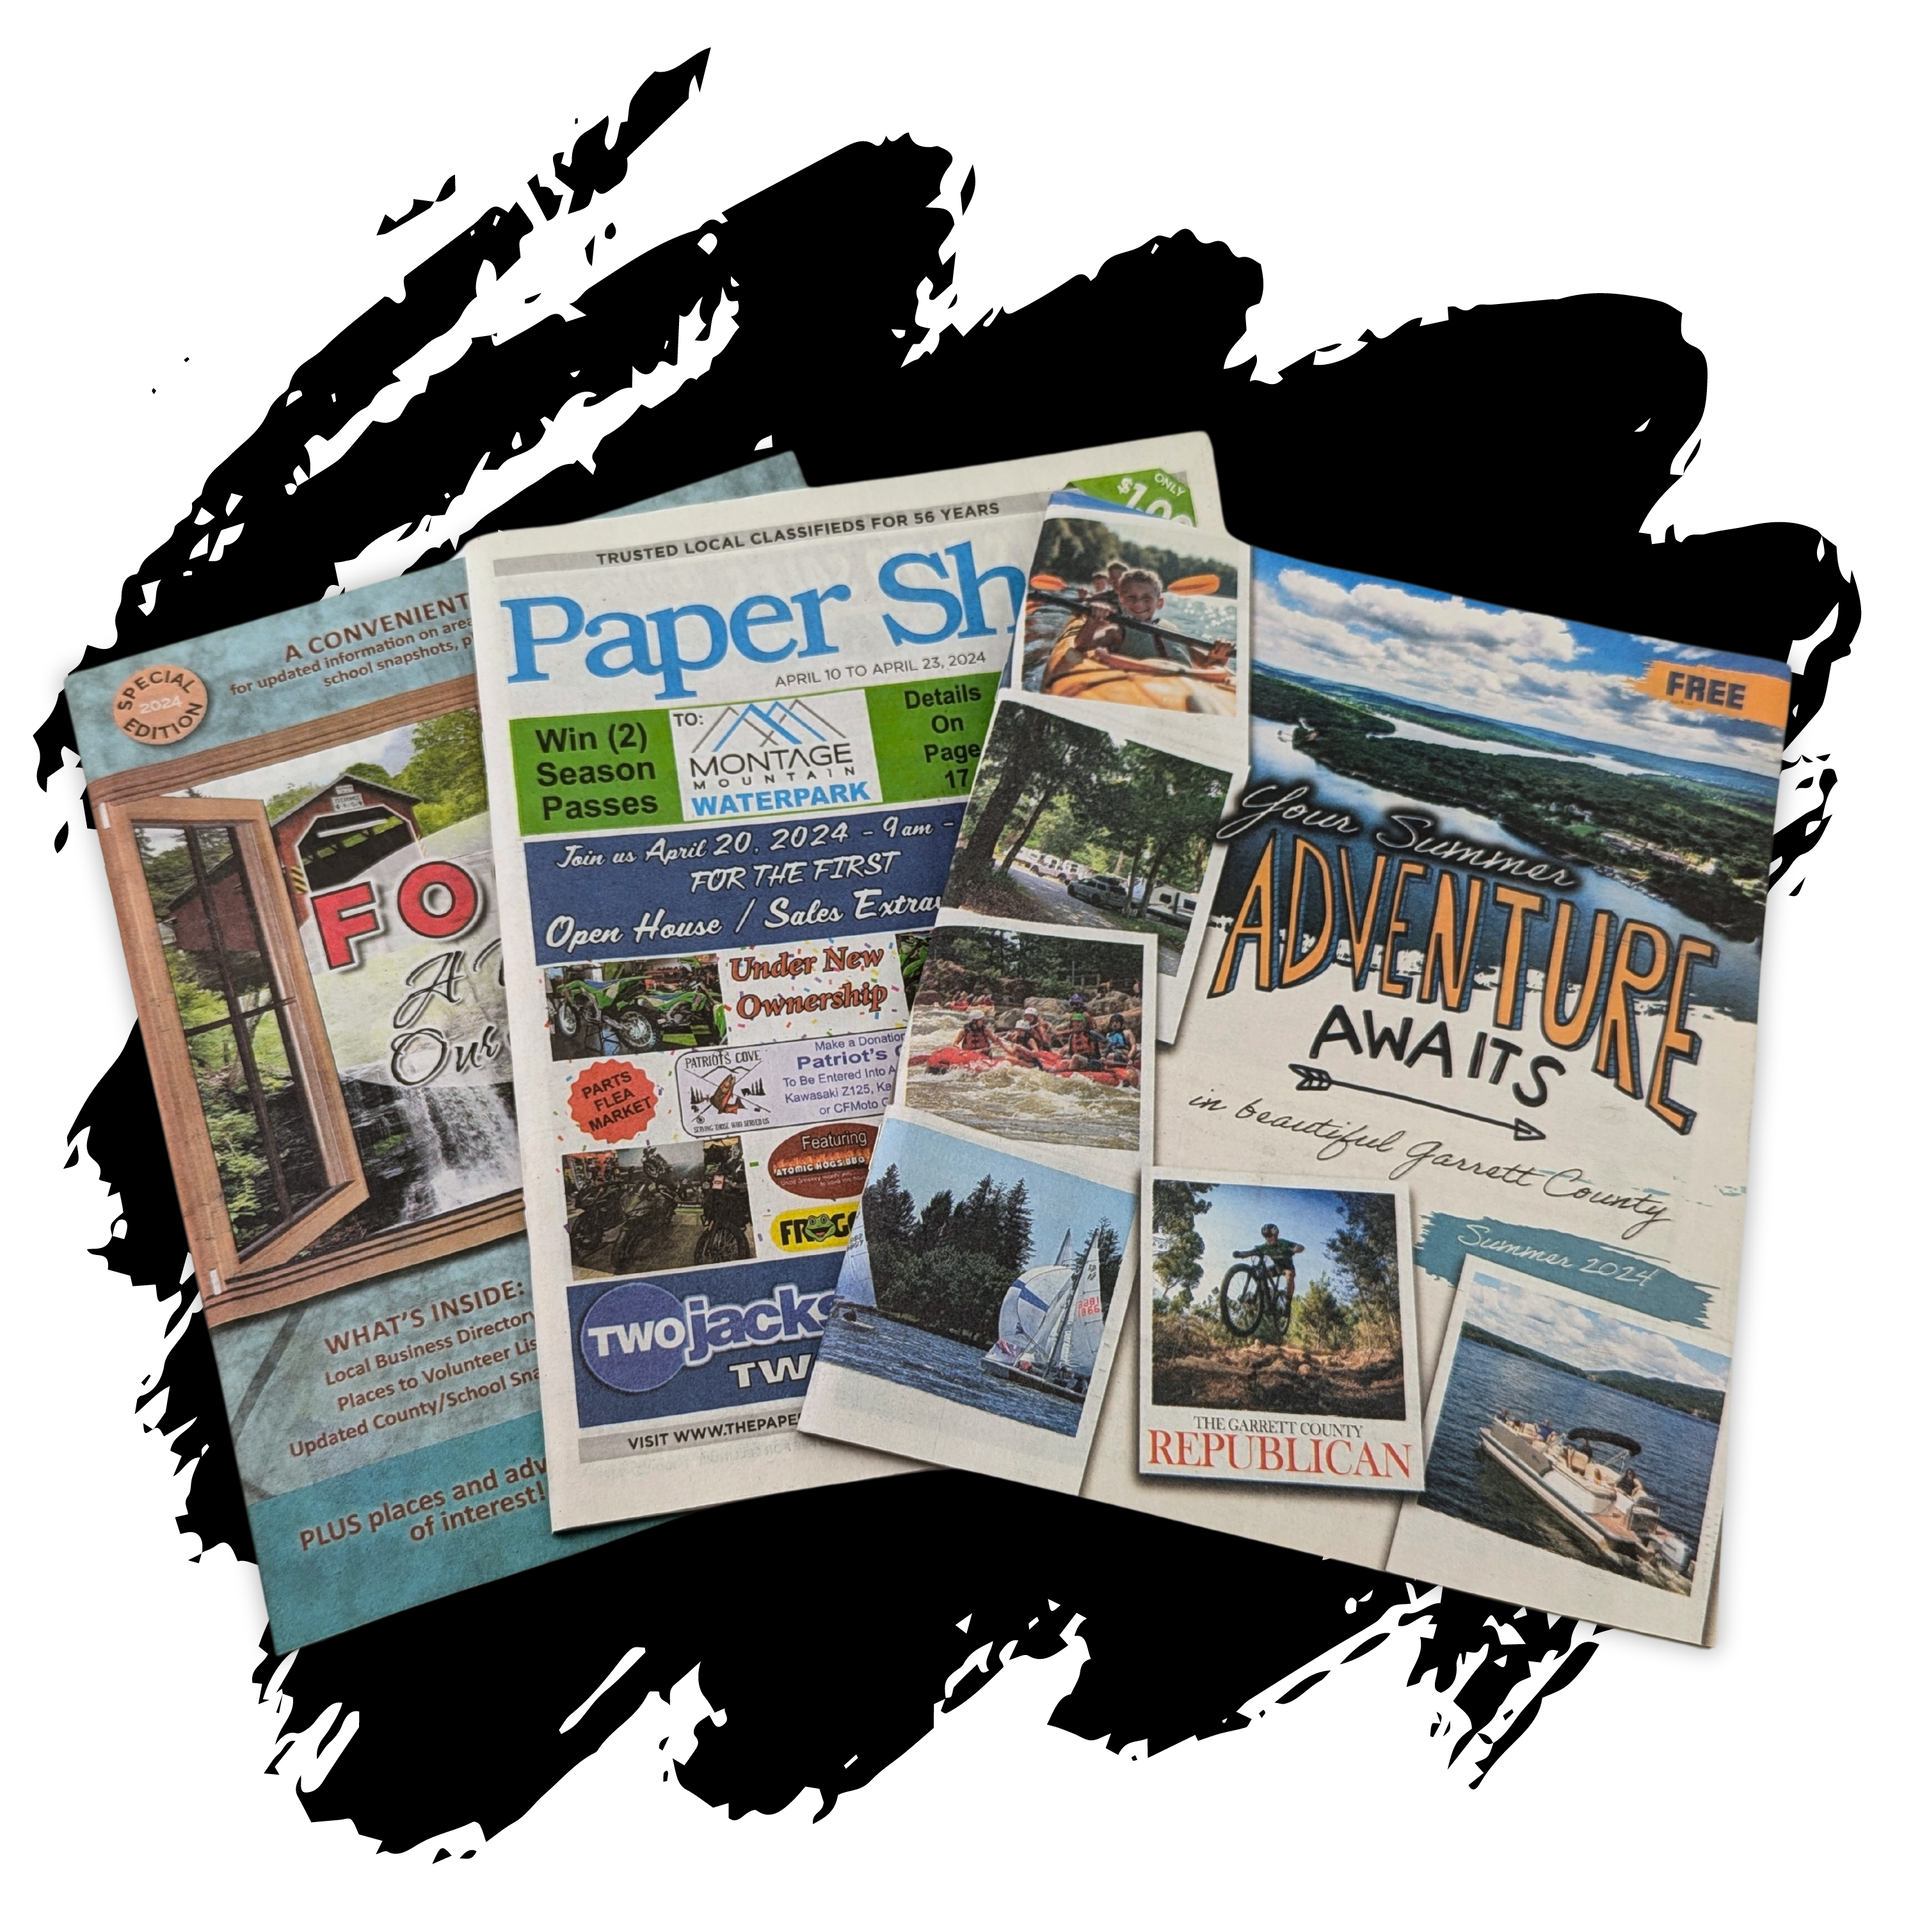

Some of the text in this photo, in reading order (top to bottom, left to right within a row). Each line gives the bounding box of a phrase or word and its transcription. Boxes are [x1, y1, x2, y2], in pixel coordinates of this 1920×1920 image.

[1155, 474, 1186, 497] ONLY
[596, 502, 1000, 565] TRUSTED LOCAL CLASSIFIEDS FOR 56 YEARS
[285, 592, 469, 663] A CONVENIENT
[499, 540, 1027, 701] Paper Sh
[230, 682, 253, 696] for
[258, 660, 322, 689] updated
[324, 634, 415, 669] information
[419, 627, 439, 641] on
[324, 664, 373, 687] school
[377, 640, 459, 671] snapshots,
[775, 651, 986, 688] APRIL 10 TO APRIL 23, 2024
[117, 670, 196, 711] SPECIAL
[139, 695, 183, 715] 2024
[903, 684, 982, 711] Details
[1665, 671, 1747, 710] FREE
[123, 702, 204, 740] EDITION
[534, 722, 648, 755] Win (2)
[673, 713, 704, 728] TO:
[931, 715, 964, 734] On
[689, 743, 855, 778] MONTAGE
[924, 743, 981, 764] Page
[535, 759, 656, 788] Season
[693, 766, 855, 790] MOUNTAIN
[945, 768, 969, 789] 17
[542, 793, 659, 821] Passes
[691, 781, 871, 817] WATERPARK
[1216, 785, 1359, 839] Your
[557, 845, 605, 869] Join
[612, 852, 636, 864] us
[645, 838, 707, 865] April
[769, 822, 849, 851] 2024
[1376, 814, 1574, 887] Summer
[690, 850, 902, 893] FOR THE FIRST
[310, 861, 479, 970] FO
[546, 915, 624, 953] Open
[634, 908, 723, 943] House
[765, 896, 843, 929] Sales
[729, 946, 885, 982] Under New
[1209, 828, 1720, 1136] ADVENTURE
[736, 982, 888, 1019] Ownership
[391, 1026, 499, 1086] Our
[735, 1050, 762, 1064] COVE
[797, 1048, 888, 1070] Patriot's
[814, 1040, 845, 1052] Make
[848, 1039, 856, 1047] a
[1309, 1005, 1566, 1107] AWAITS
[581, 1070, 633, 1099] PARTS
[783, 1065, 897, 1088] To Be Entered Into A
[785, 1082, 892, 1104] Kawasaki Z125, Ka
[588, 1097, 653, 1132] MARKET
[593, 1088, 636, 1113] FLEA
[819, 1106, 831, 1116] or
[834, 1100, 879, 1114] CFMoto
[693, 1125, 714, 1134] SERVING
[714, 1123, 730, 1131] THOSE
[743, 1119, 762, 1127] SERVED
[763, 1117, 770, 1125] US
[801, 1132, 867, 1151] Featuring
[776, 1156, 866, 1177] ATOMIC HOGS BBQ
[1188, 1088, 1228, 1112] in
[1235, 1098, 1407, 1161] beautiful
[1542, 1168, 1671, 1240] County
[1457, 1224, 1660, 1287] Summer 2024
[324, 1280, 526, 1355] WHAT'S INSIDE:
[325, 1358, 371, 1386] Local
[375, 1336, 453, 1370] Business
[337, 1338, 537, 1411] Places to Volunteer Lis
[729, 1353, 813, 1388] TW
[290, 1368, 539, 1457] Updated County/School Sna
[1193, 1416, 1363, 1438] THE GARRETT COUNTY
[628, 1432, 670, 1450] VISIT
[1147, 1428, 1413, 1479] REPUBLICAN
[299, 1457, 547, 1551] PLUS places and adv
[410, 1481, 546, 1541] of interest!
